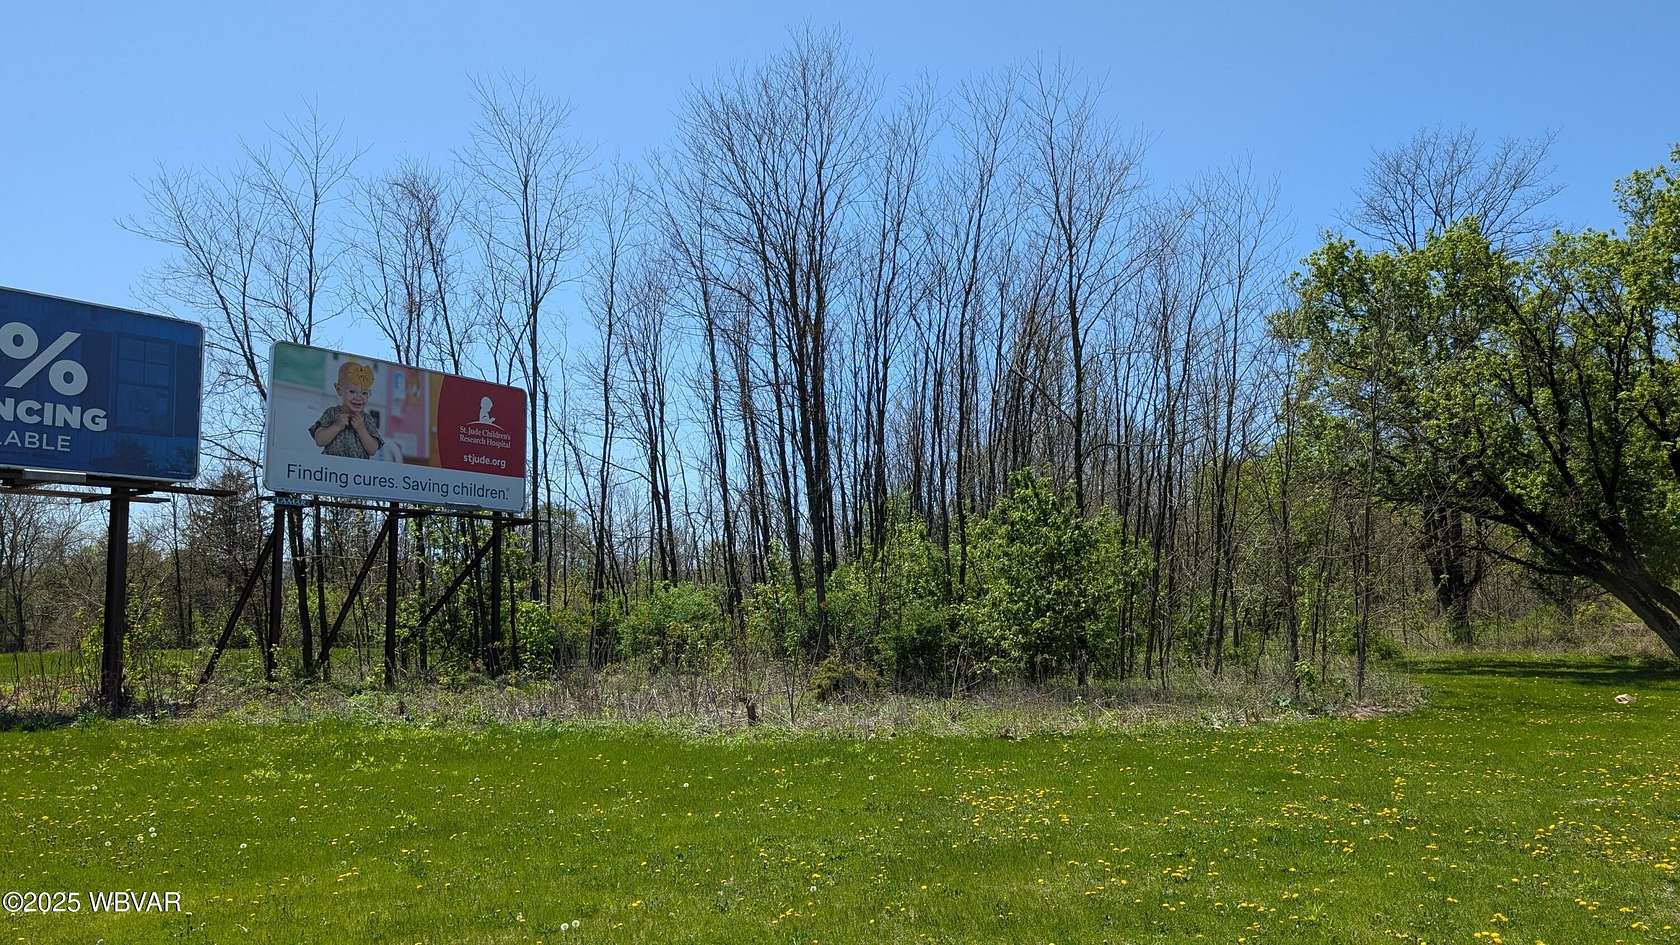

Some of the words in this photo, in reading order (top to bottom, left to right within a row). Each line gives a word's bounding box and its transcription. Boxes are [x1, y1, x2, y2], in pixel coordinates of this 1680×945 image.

[0, 430, 72, 452] ABLE
[459, 434, 486, 446] Research
[486, 437, 511, 449] Hospital
[468, 427, 481, 436] Jude
[482, 429, 511, 441] Children's
[463, 454, 507, 469] stjude.org
[287, 463, 349, 489] Finding
[353, 473, 398, 489] cures.
[402, 475, 450, 498] Saving
